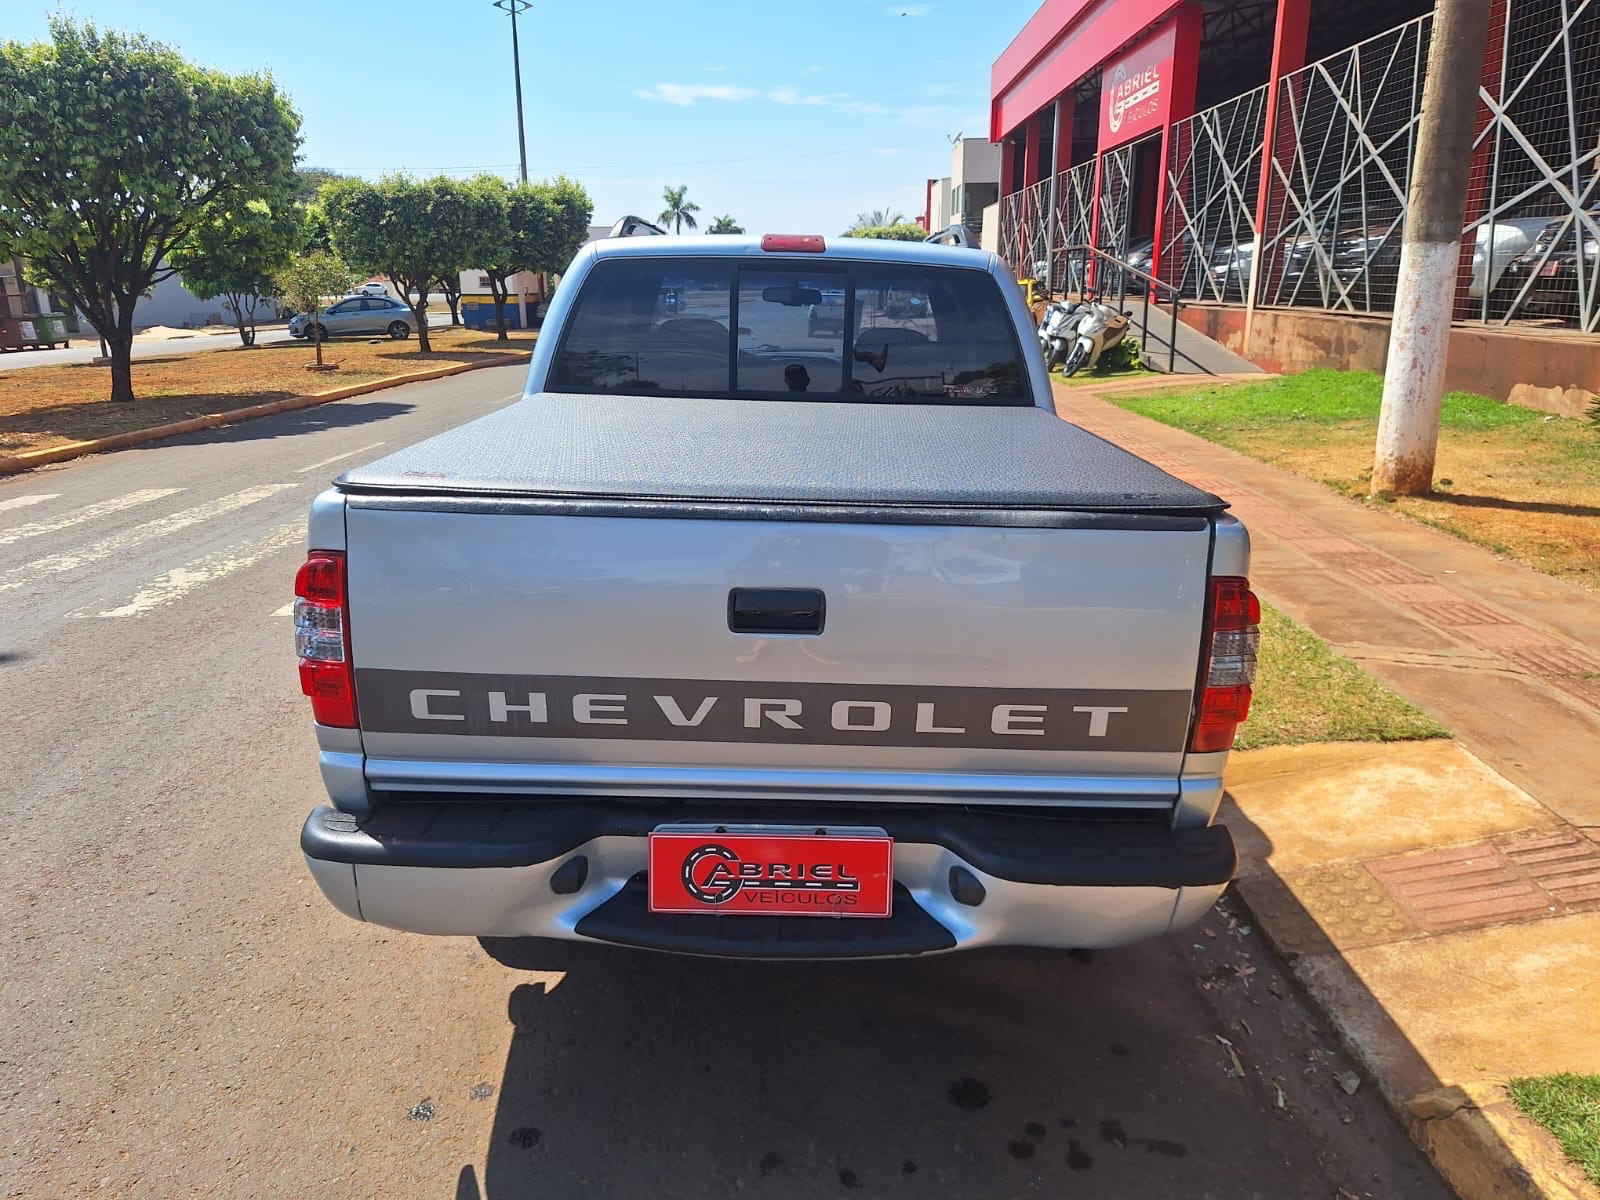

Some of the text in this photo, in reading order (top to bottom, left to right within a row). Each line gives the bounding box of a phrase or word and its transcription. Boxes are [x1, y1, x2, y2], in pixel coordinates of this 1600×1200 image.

[409, 689, 1128, 737] CHEVROLET
[682, 845, 860, 904] GABRIEL
[744, 890, 858, 905] VEÍCULOS
